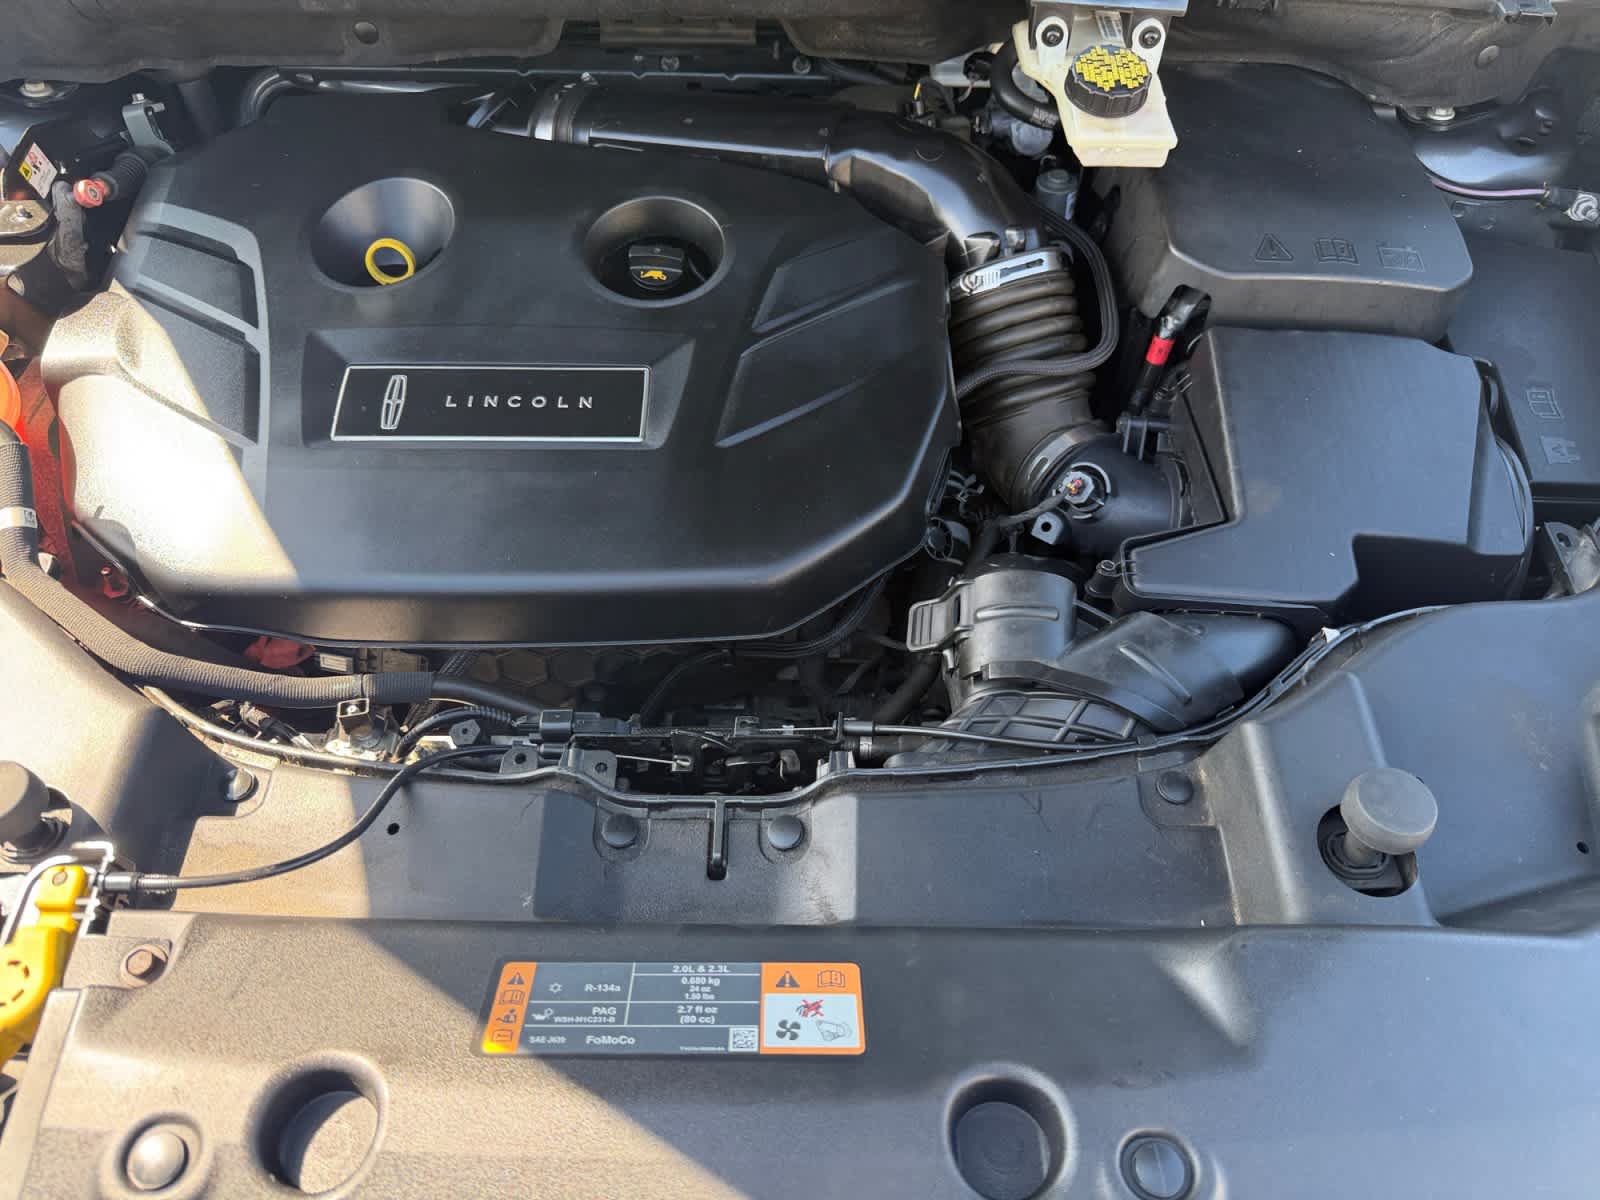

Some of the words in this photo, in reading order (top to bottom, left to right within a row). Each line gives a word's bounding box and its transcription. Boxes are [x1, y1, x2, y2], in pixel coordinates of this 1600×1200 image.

[445, 395, 593, 409] LINCOLN
[672, 965, 695, 973] 2.0L
[697, 965, 706, 973] &
[708, 965, 731, 973] 2.3L
[708, 977, 721, 986] kg
[584, 984, 621, 992] R-134a
[592, 1007, 617, 1015] PAG
[677, 1006, 694, 1014] 2.7
[680, 1015, 697, 1024] (80
[698, 1015, 715, 1024] cc)
[586, 1035, 636, 1044] FoMoCo
